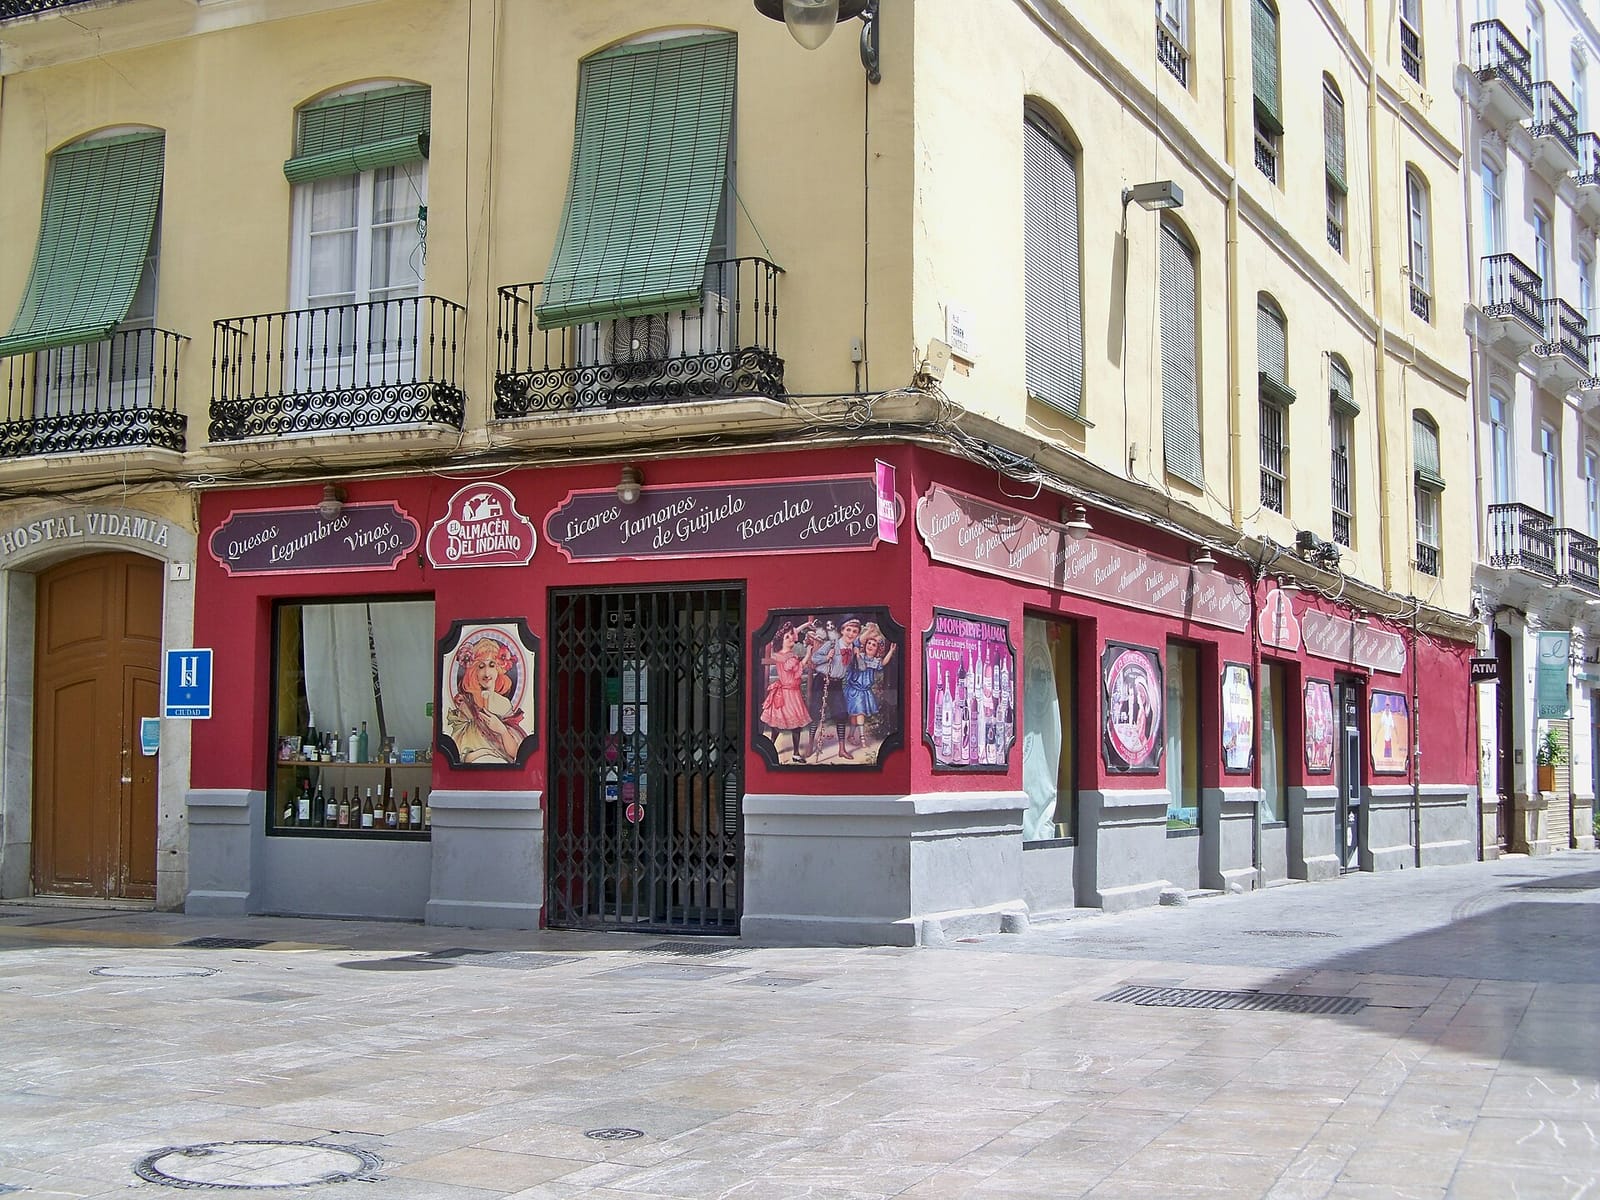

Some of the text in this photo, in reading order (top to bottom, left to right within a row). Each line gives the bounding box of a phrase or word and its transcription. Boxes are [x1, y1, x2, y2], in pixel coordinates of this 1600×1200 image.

[0, 513, 168, 554] HOSTAL VIDAMIA
[449, 522, 459, 532] EL
[564, 505, 622, 542] Licores
[619, 496, 697, 544] Jamones
[652, 494, 746, 549] de Guijuelo
[736, 498, 814, 540] Bacalao
[800, 501, 865, 540] Aceites
[930, 509, 960, 538] Licores
[958, 511, 1000, 547] Conservas
[228, 525, 280, 560] Quesos
[269, 515, 350, 563] Legumbres
[344, 522, 393, 552] Vinos
[374, 534, 402, 556] D.O.
[446, 535, 520, 560] DEL INDIANO
[974, 538, 986, 559] de
[1008, 532, 1049, 569] Legumbres
[177, 566, 183, 577] 7
[1050, 540, 1080, 573] Jamones
[1093, 555, 1121, 586] Bacalao
[1471, 663, 1497, 674] ATM
